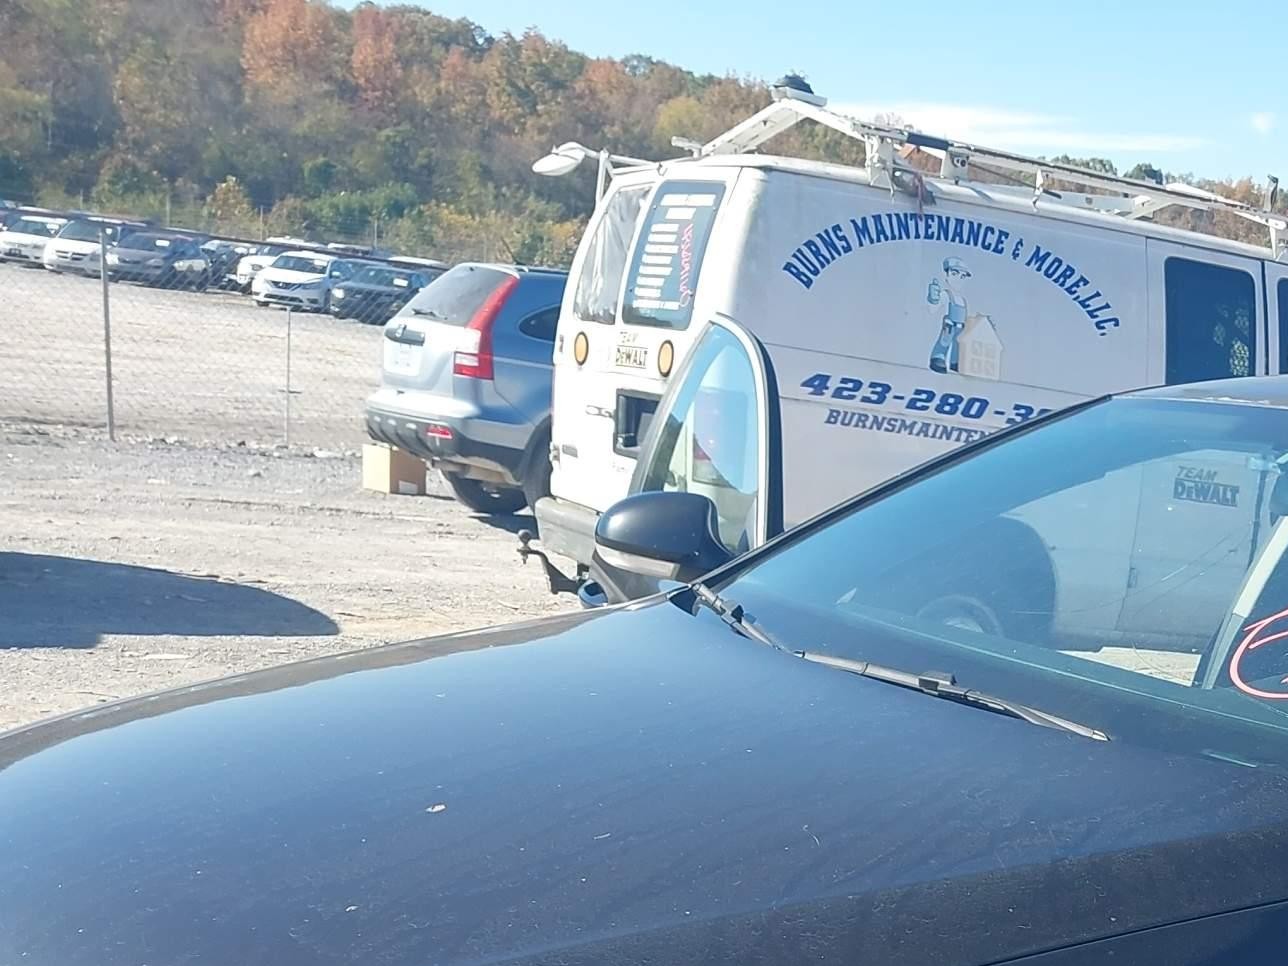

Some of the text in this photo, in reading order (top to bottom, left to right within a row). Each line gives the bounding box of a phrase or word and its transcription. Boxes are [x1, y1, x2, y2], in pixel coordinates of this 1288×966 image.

[782, 223, 853, 290] BURNS
[849, 212, 1010, 255] MAINTENANCE
[1011, 238, 1024, 261] &
[800, 373, 1054, 426] 423-280-3
[1177, 465, 1218, 481] TEAM
